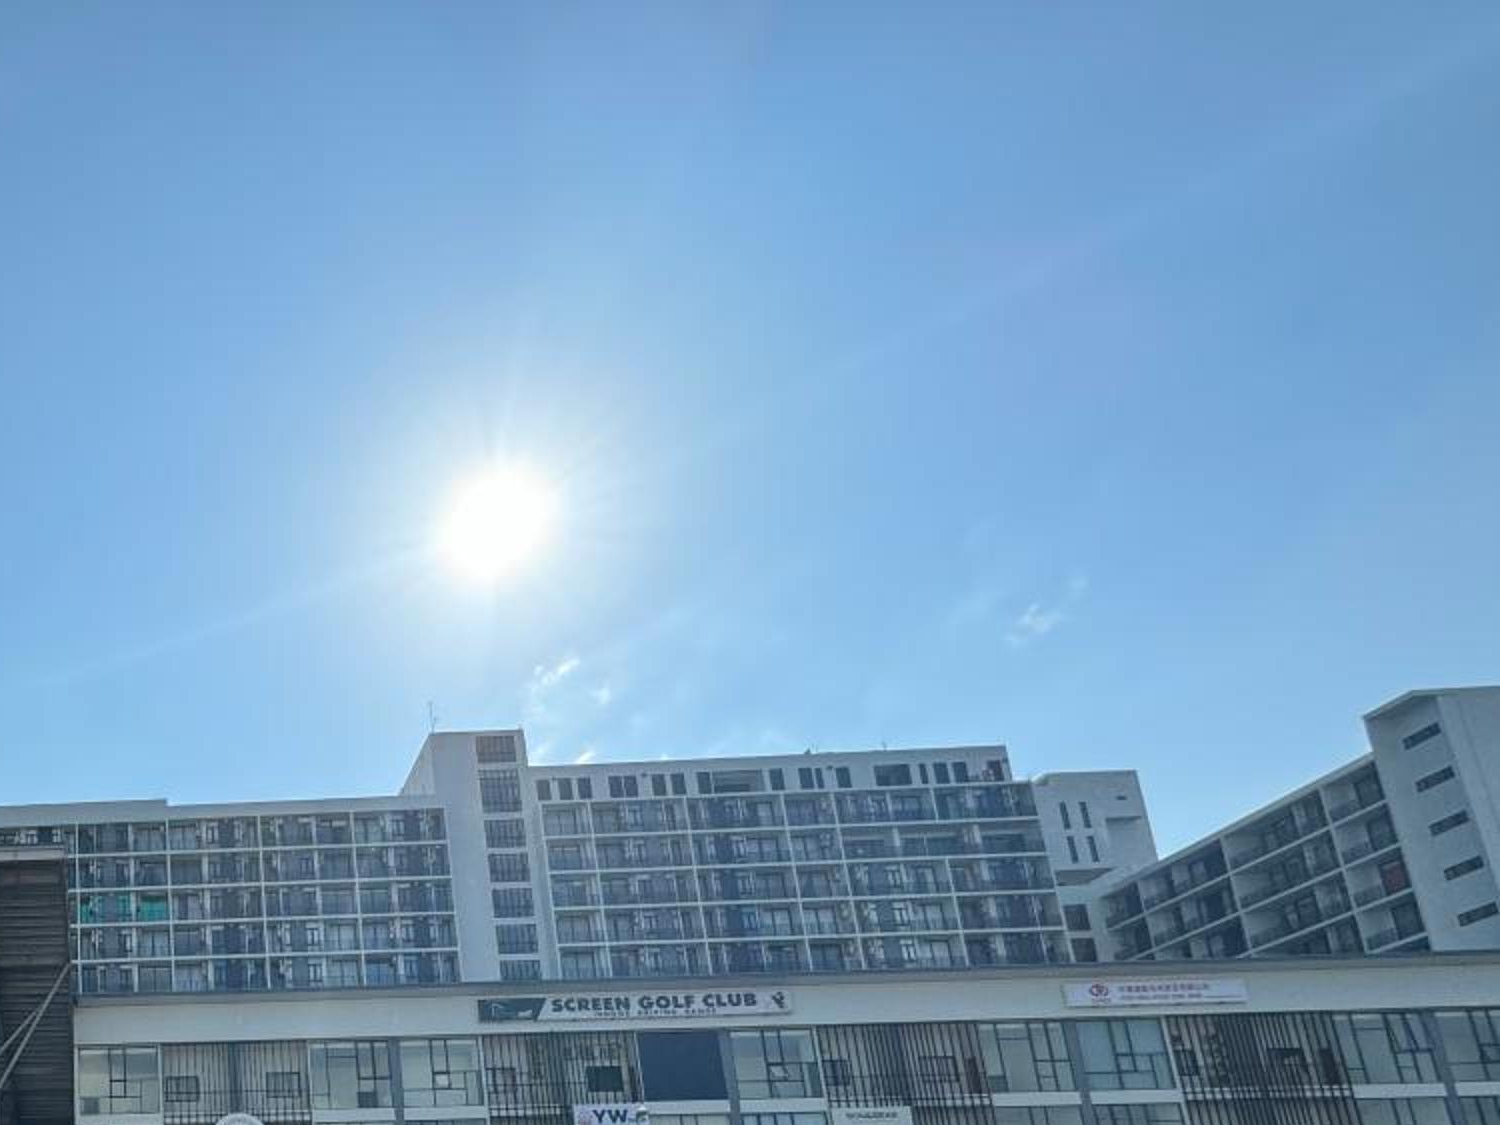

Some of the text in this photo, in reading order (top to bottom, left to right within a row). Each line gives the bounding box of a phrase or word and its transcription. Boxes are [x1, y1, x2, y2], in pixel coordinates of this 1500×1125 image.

[551, 991, 758, 1013] SCREEN GOLF CLUB
[592, 1109, 628, 1124] YW
